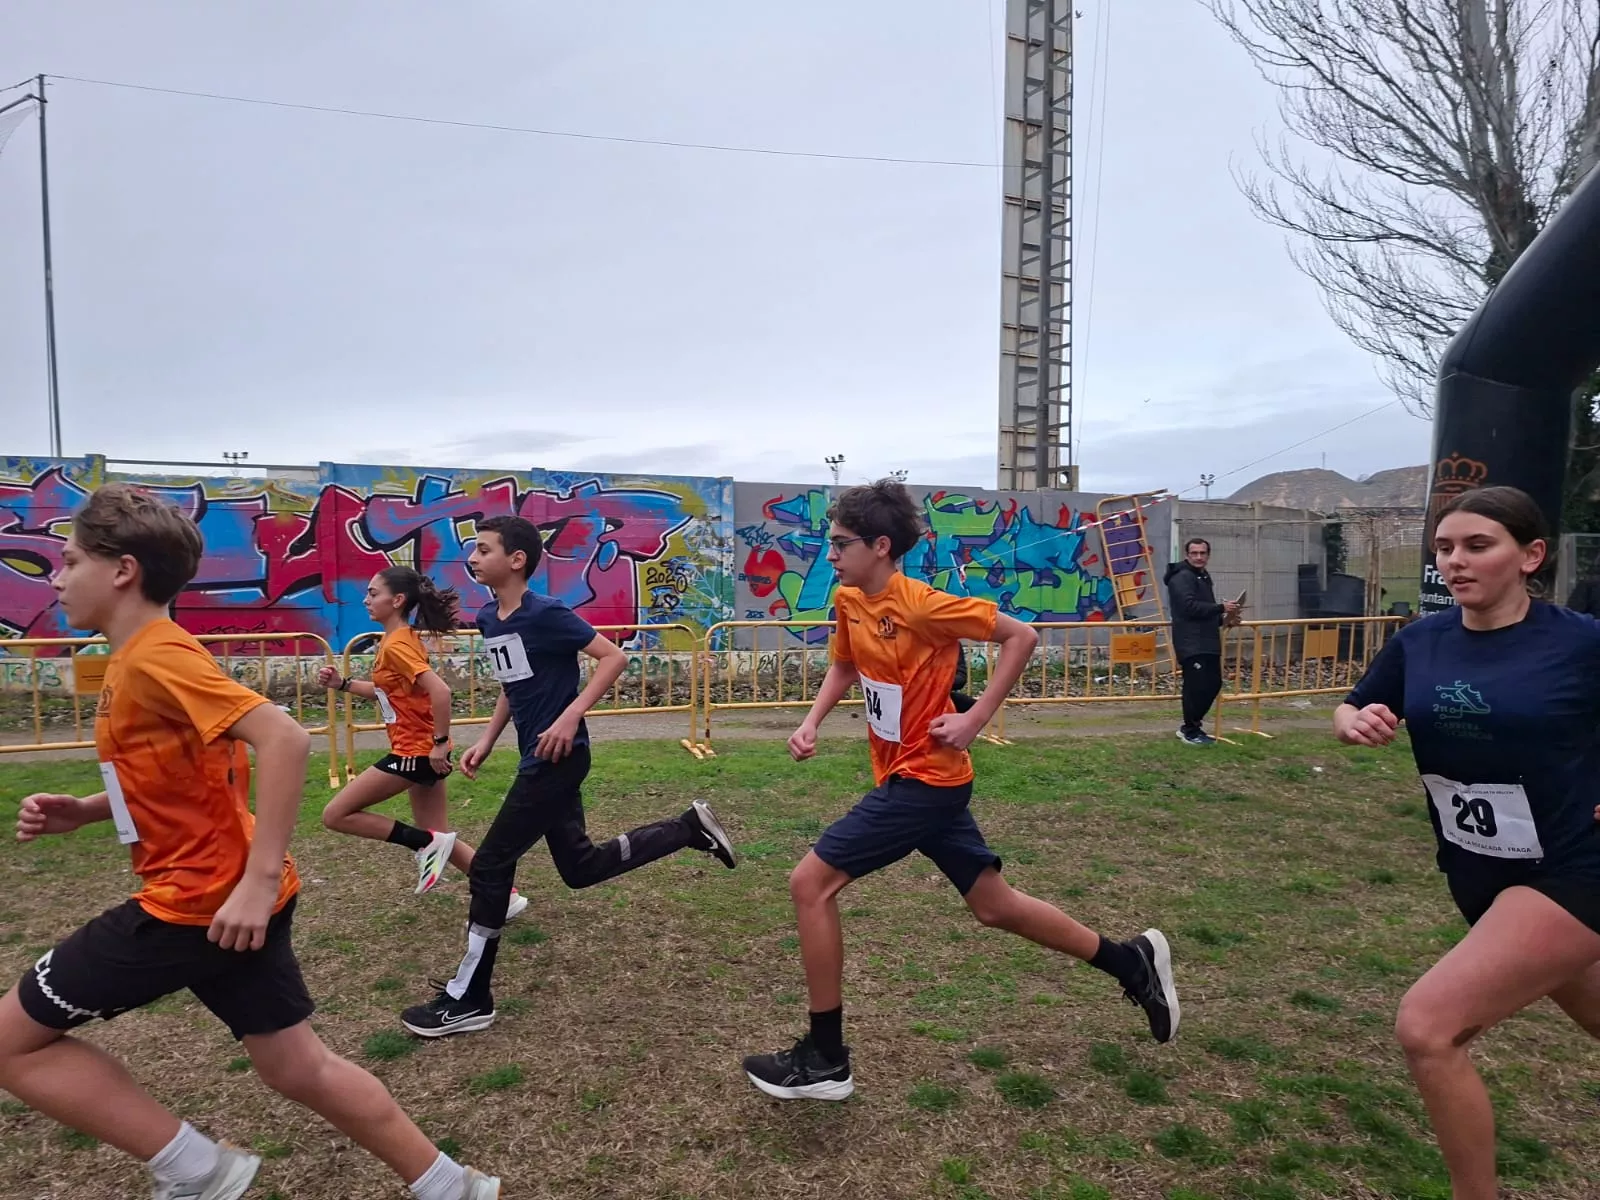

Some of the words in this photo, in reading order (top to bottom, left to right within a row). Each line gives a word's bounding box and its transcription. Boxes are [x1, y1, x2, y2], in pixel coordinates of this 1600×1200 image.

[646, 566, 688, 594] 2025
[866, 687, 882, 720] 64
[1452, 793, 1498, 838] 29
